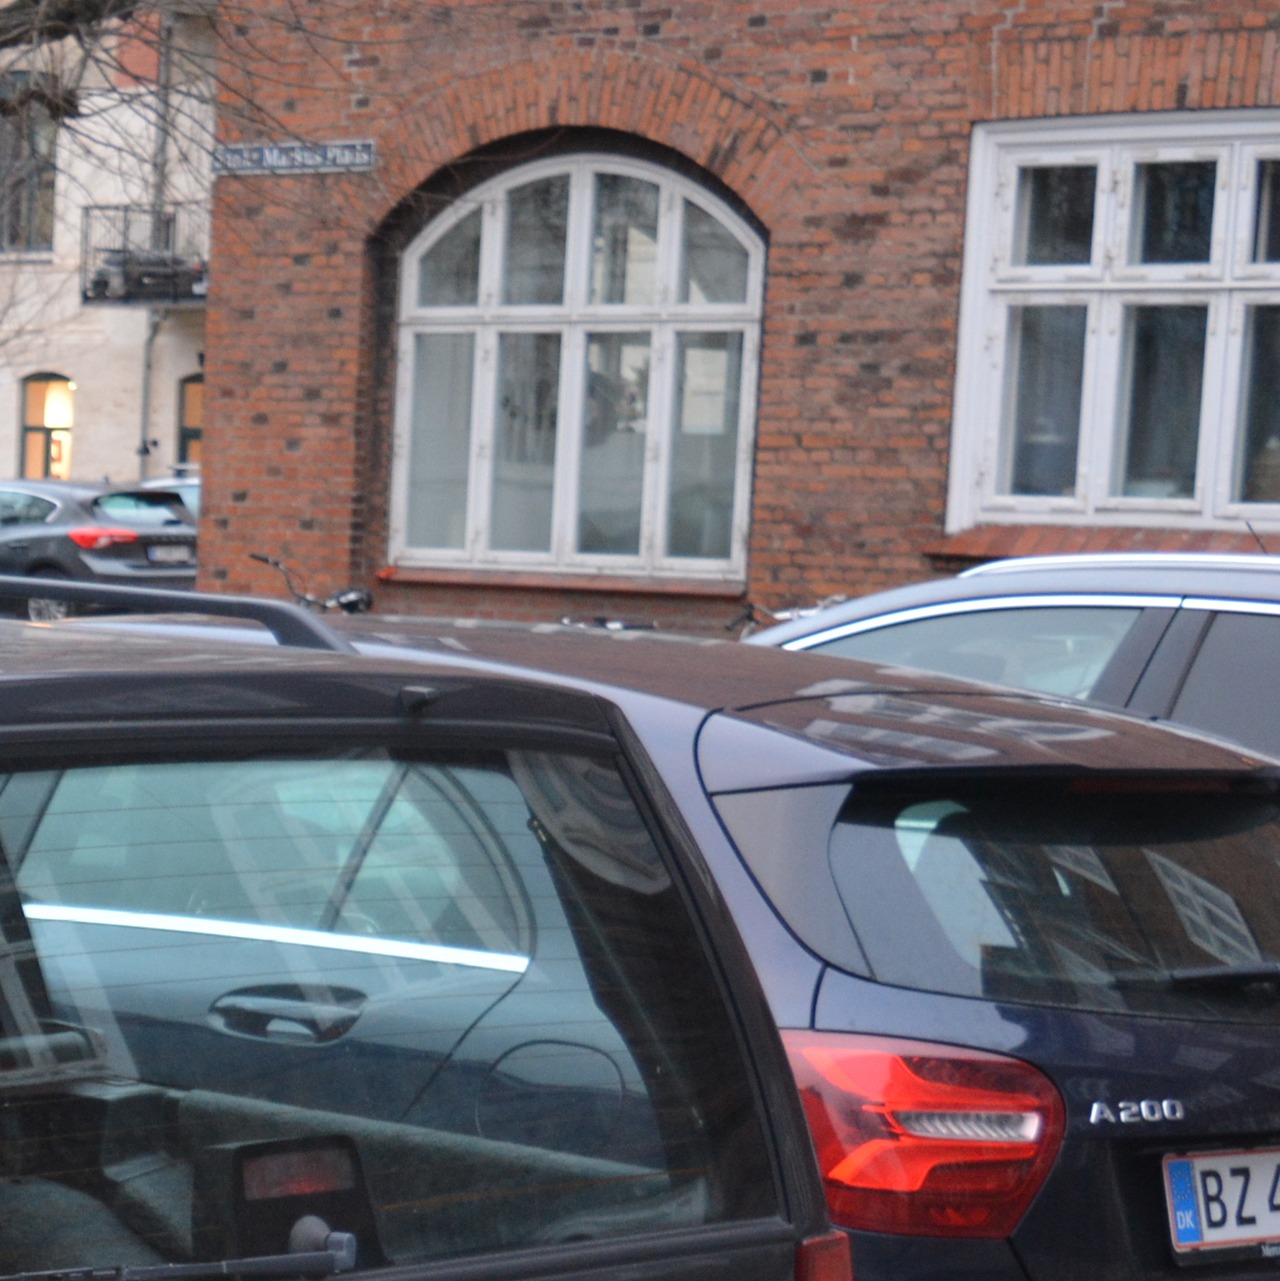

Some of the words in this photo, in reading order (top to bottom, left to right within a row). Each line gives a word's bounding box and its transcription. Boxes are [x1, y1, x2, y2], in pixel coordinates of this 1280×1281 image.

[1089, 1101, 1116, 1125] A
[1118, 1098, 1185, 1124] 200
[1199, 1166, 1257, 1229] BZ
[1176, 1210, 1195, 1230] DK
